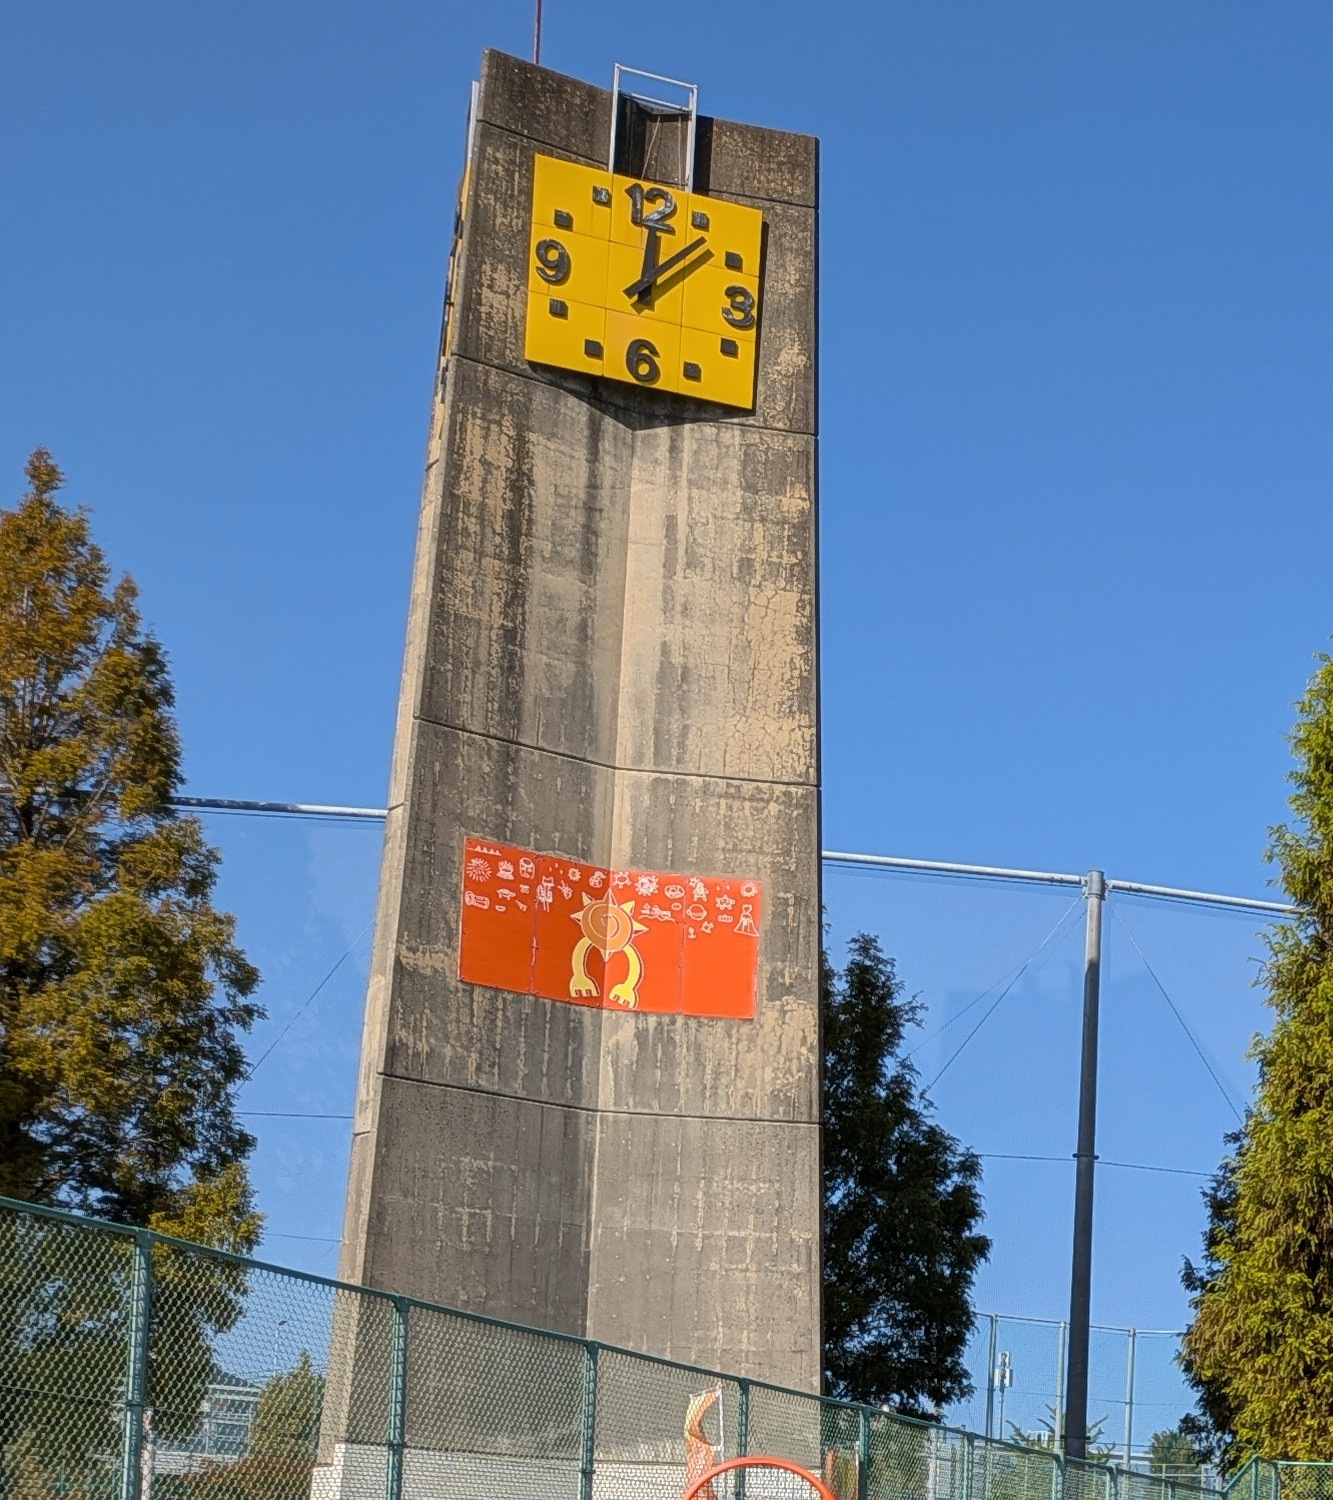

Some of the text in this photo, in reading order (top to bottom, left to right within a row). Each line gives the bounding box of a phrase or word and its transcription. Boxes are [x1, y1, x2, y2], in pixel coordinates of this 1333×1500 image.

[624, 183, 676, 232] 12
[535, 238, 570, 283] 9
[721, 285, 755, 328] 3
[625, 338, 660, 383] 6
